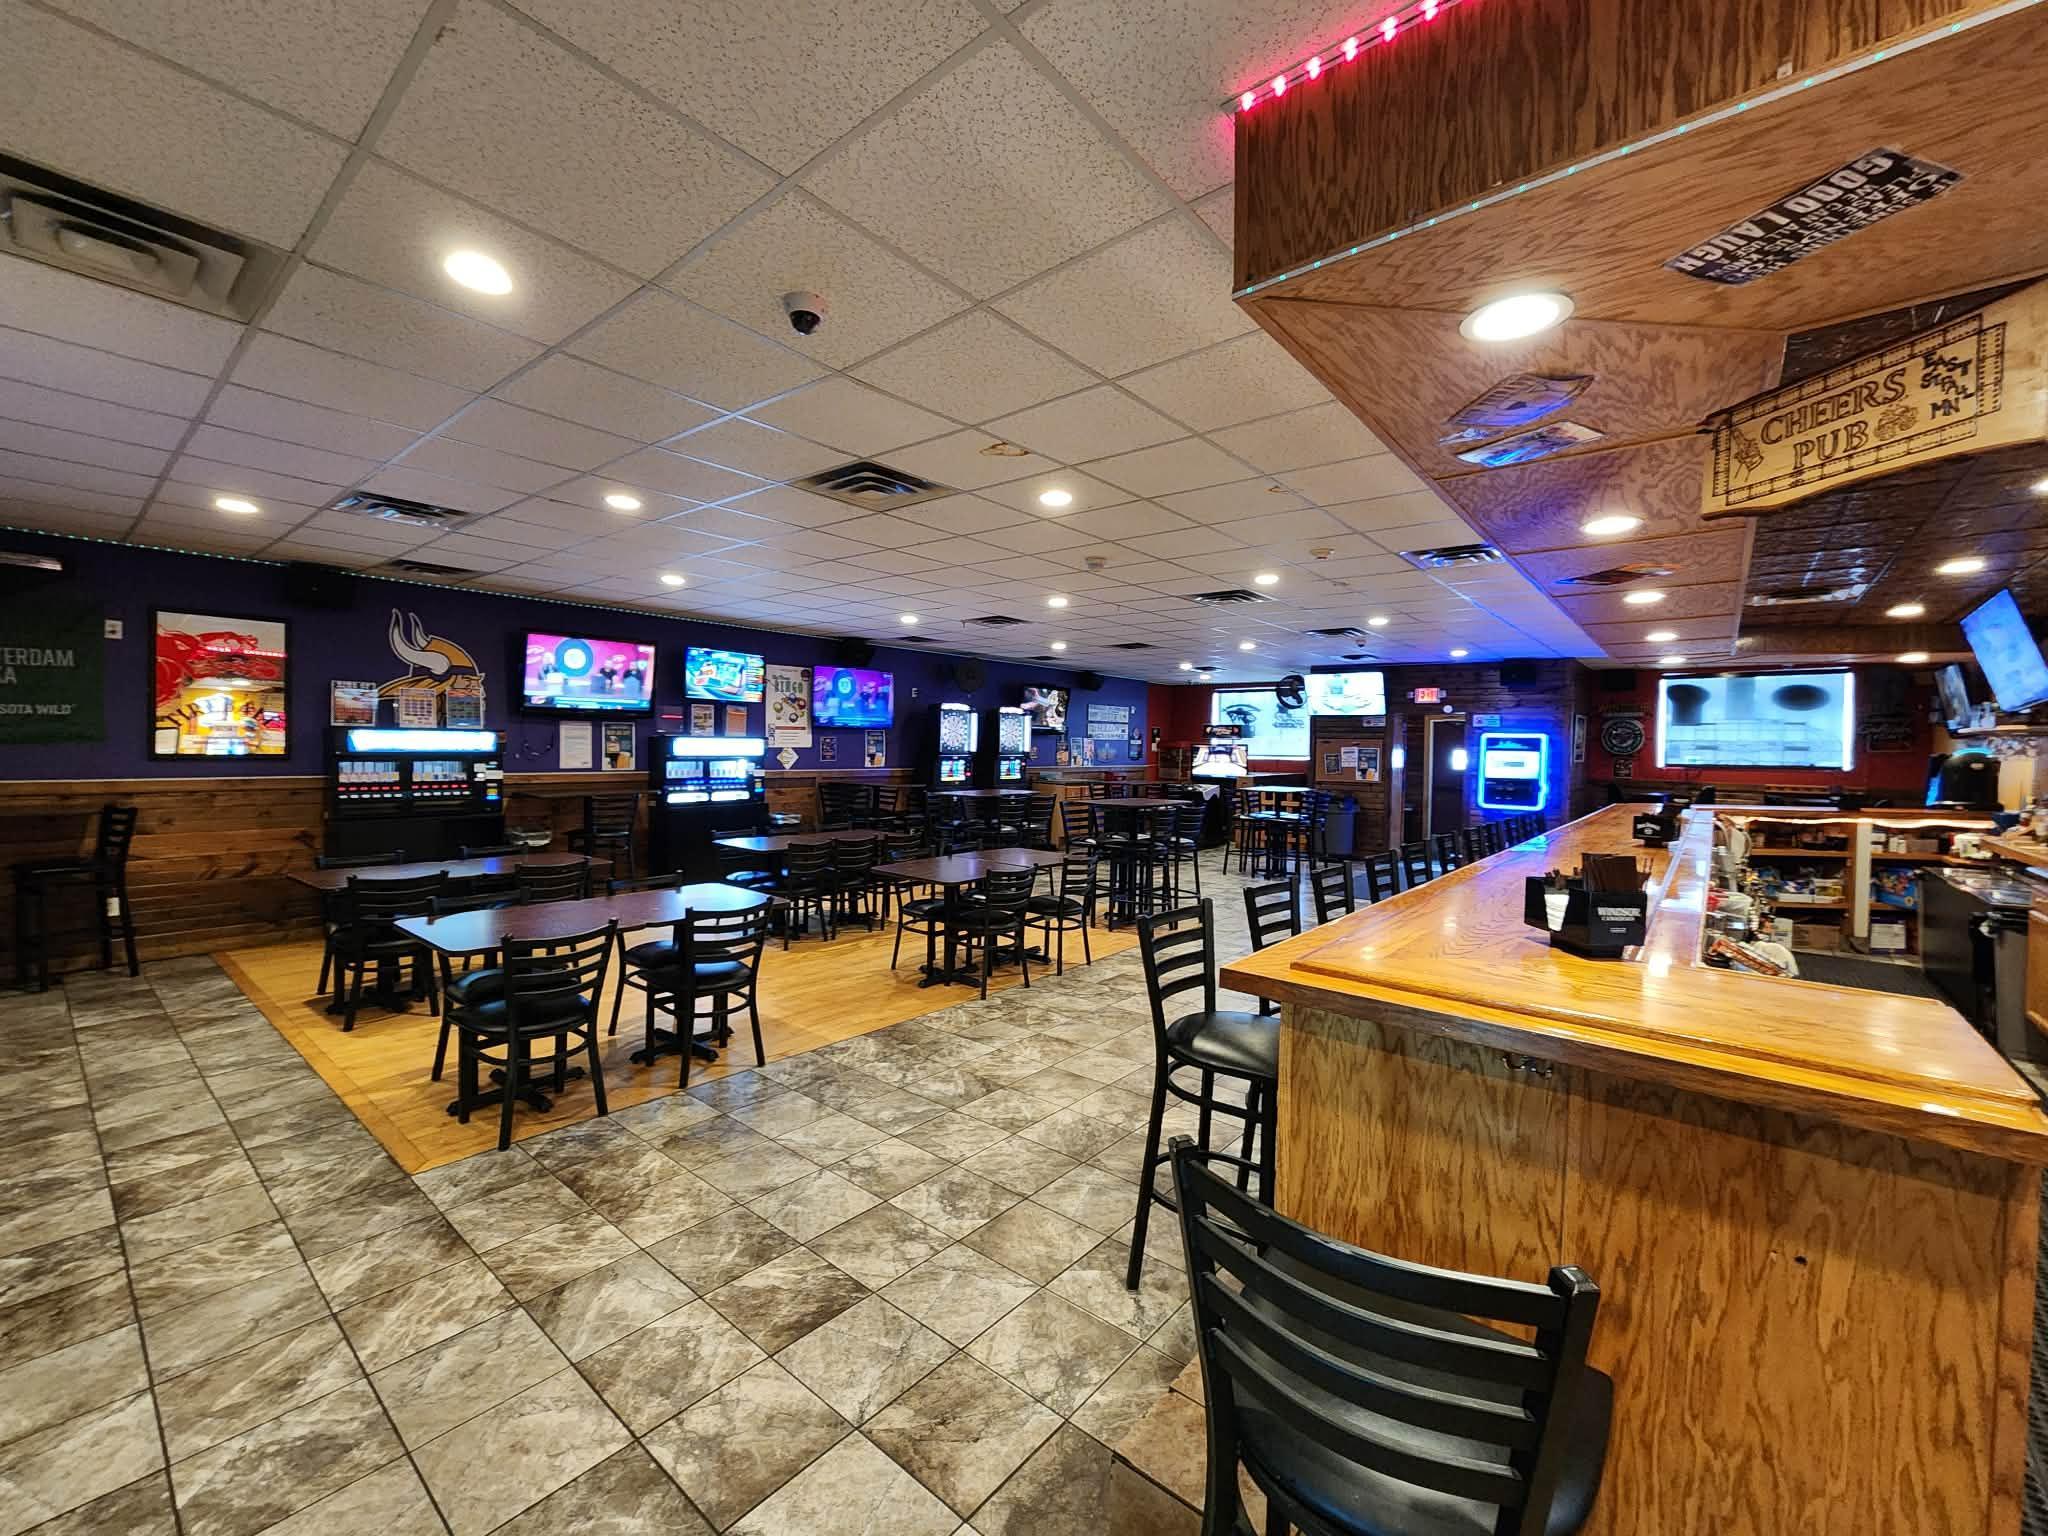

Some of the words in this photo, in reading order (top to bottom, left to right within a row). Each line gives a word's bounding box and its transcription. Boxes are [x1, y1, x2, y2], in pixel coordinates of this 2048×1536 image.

[1781, 155, 1894, 215] GOOD
[1833, 168, 1924, 215] PLEASE
[1839, 184, 1877, 202] WE
[1782, 173, 1941, 252] OFFENDS
[1798, 202, 1842, 222] CAN
[1763, 223, 1801, 239] ALL
[1793, 215, 1836, 236] LET
[1671, 211, 1792, 272] LAUGH
[1730, 240, 1767, 257] USE
[1762, 237, 1796, 252] US
[1922, 351, 1972, 376] EAST
[1760, 367, 1908, 445] CHEERS
[1930, 398, 1961, 420] MN
[1792, 420, 1869, 472] PUB
[0, 648, 75, 667] ERDAM
[36, 704, 73, 714] WILD
